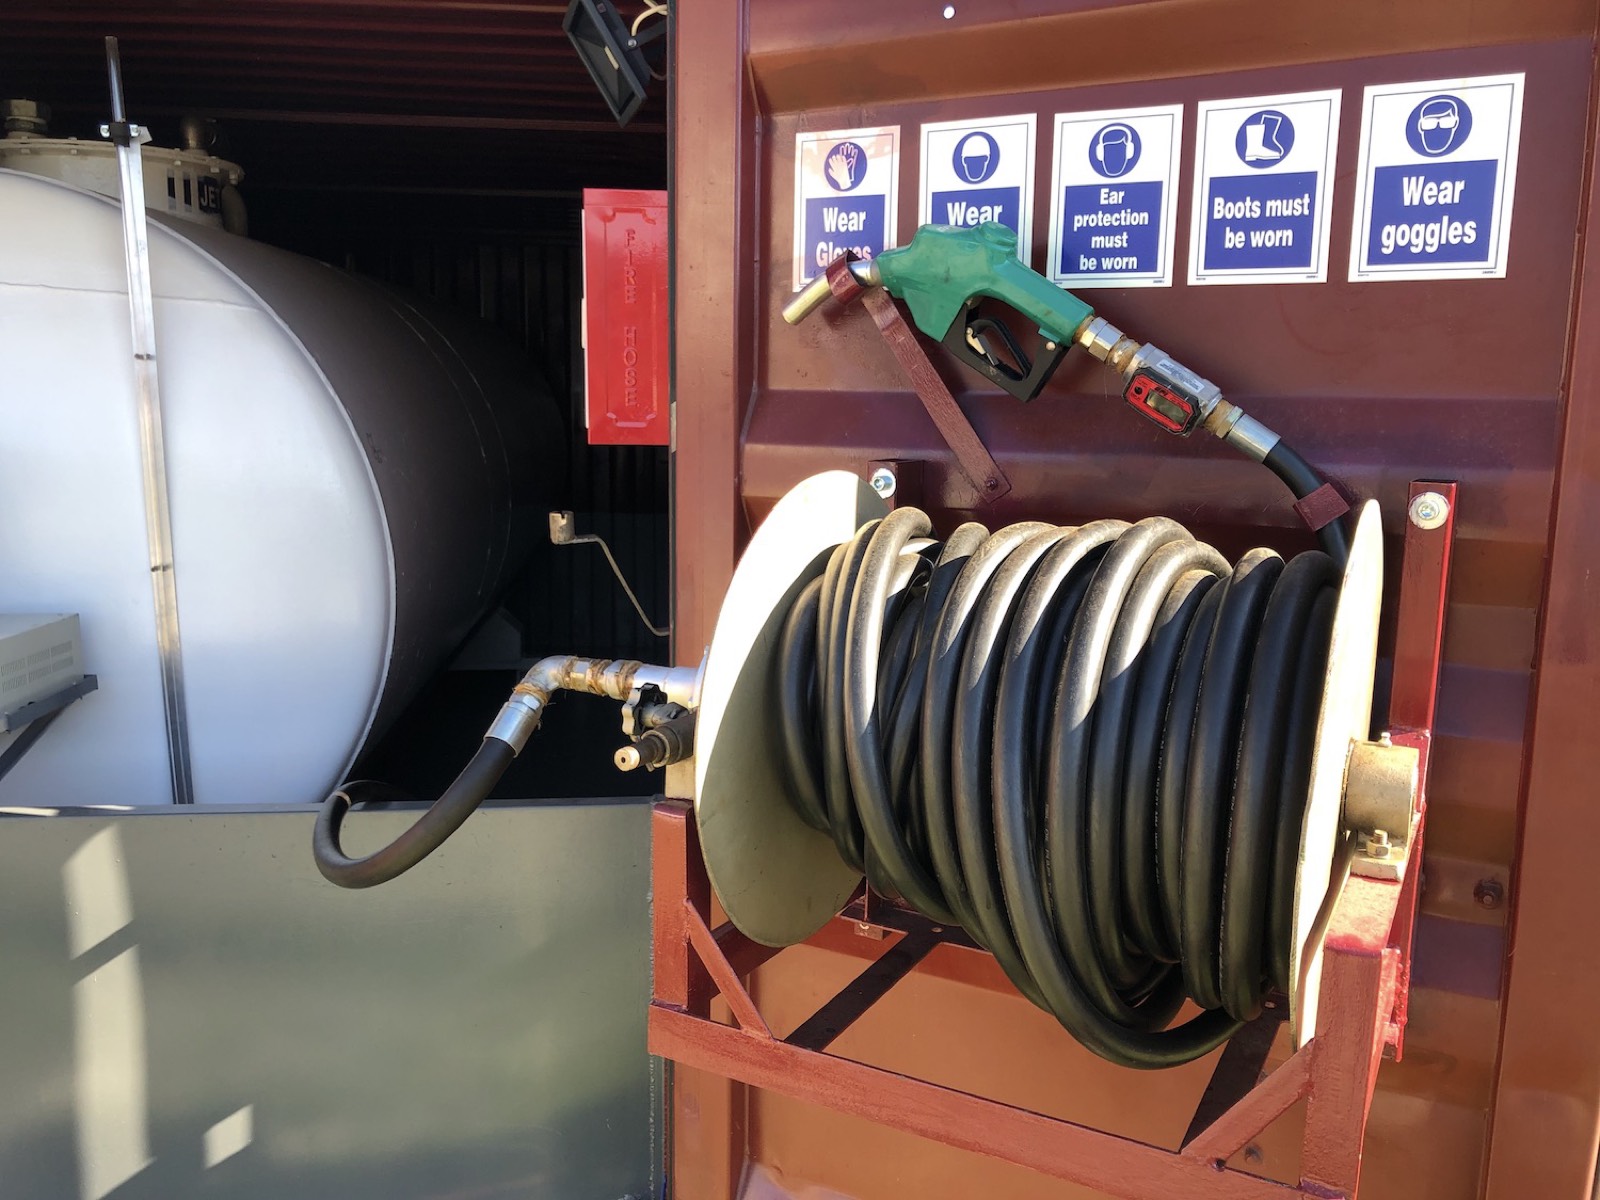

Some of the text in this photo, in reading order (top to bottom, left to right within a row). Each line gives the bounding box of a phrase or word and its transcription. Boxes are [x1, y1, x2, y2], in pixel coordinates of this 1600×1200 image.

[1100, 188, 1126, 205] Ear
[1402, 175, 1466, 207] Wear
[946, 201, 1004, 227] Wear
[1213, 193, 1311, 220] Boots must
[822, 207, 867, 233] Wear
[1073, 208, 1150, 232] protection
[1091, 231, 1129, 249] must
[1224, 226, 1294, 249] be worn
[1381, 215, 1477, 255] goggles
[1079, 254, 1138, 271] be worn
[623, 228, 639, 408] FIRE HOSE
